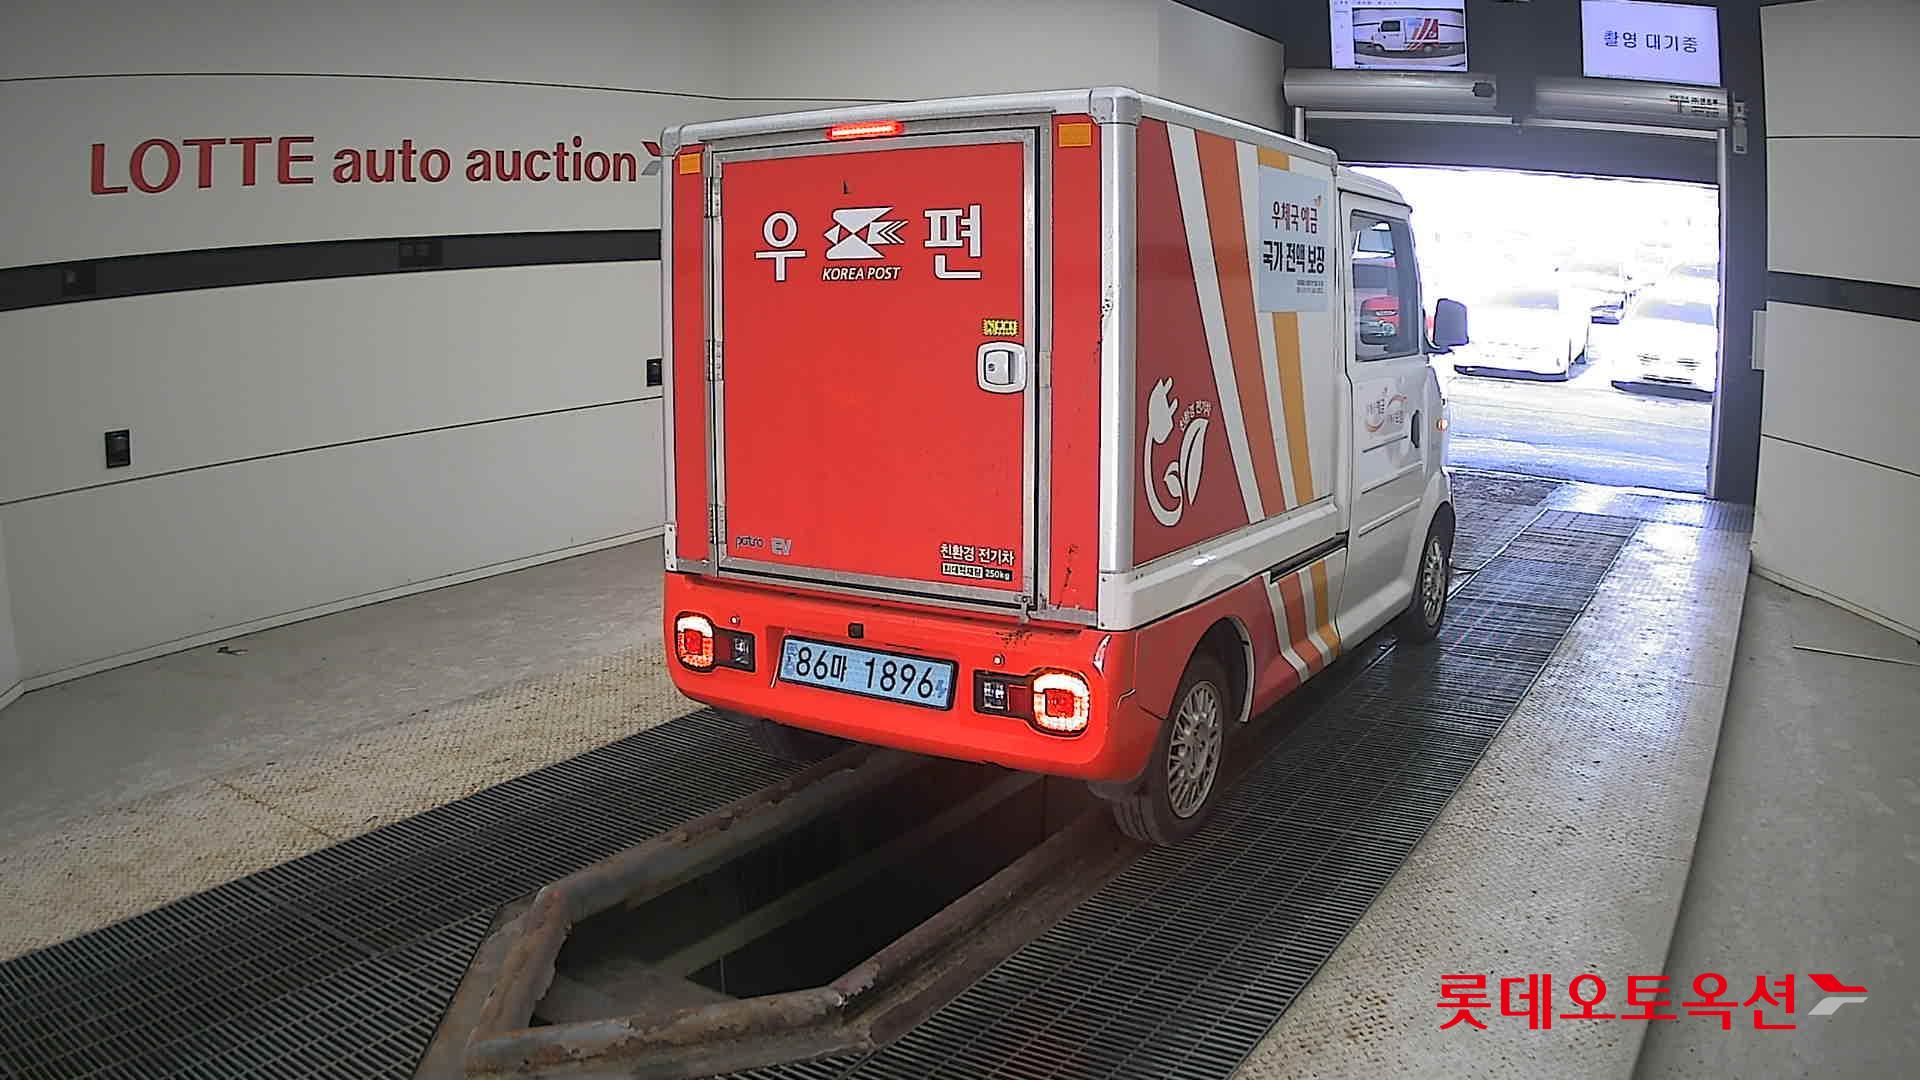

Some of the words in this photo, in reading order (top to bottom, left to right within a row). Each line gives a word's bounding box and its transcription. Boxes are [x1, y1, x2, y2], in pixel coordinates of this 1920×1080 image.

[1645, 33, 1698, 53] 대기중
[90, 136, 315, 195] LOTTE
[332, 139, 451, 183] auto
[465, 136, 637, 182] auction
[1272, 201, 1299, 231] 우체국
[1301, 206, 1318, 234] 예금
[755, 211, 806, 282] 우
[924, 203, 982, 280] 편
[1263, 240, 1283, 272] 국가
[1286, 242, 1306, 273] 전액
[1307, 246, 1325, 274] 보장
[822, 267, 865, 281] KOREA
[867, 266, 902, 280] POST
[771, 537, 792, 556] EV
[940, 543, 975, 562] 친환경
[979, 548, 1015, 566] 전기차
[796, 646, 847, 682] 86마
[864, 657, 934, 698] 1896
